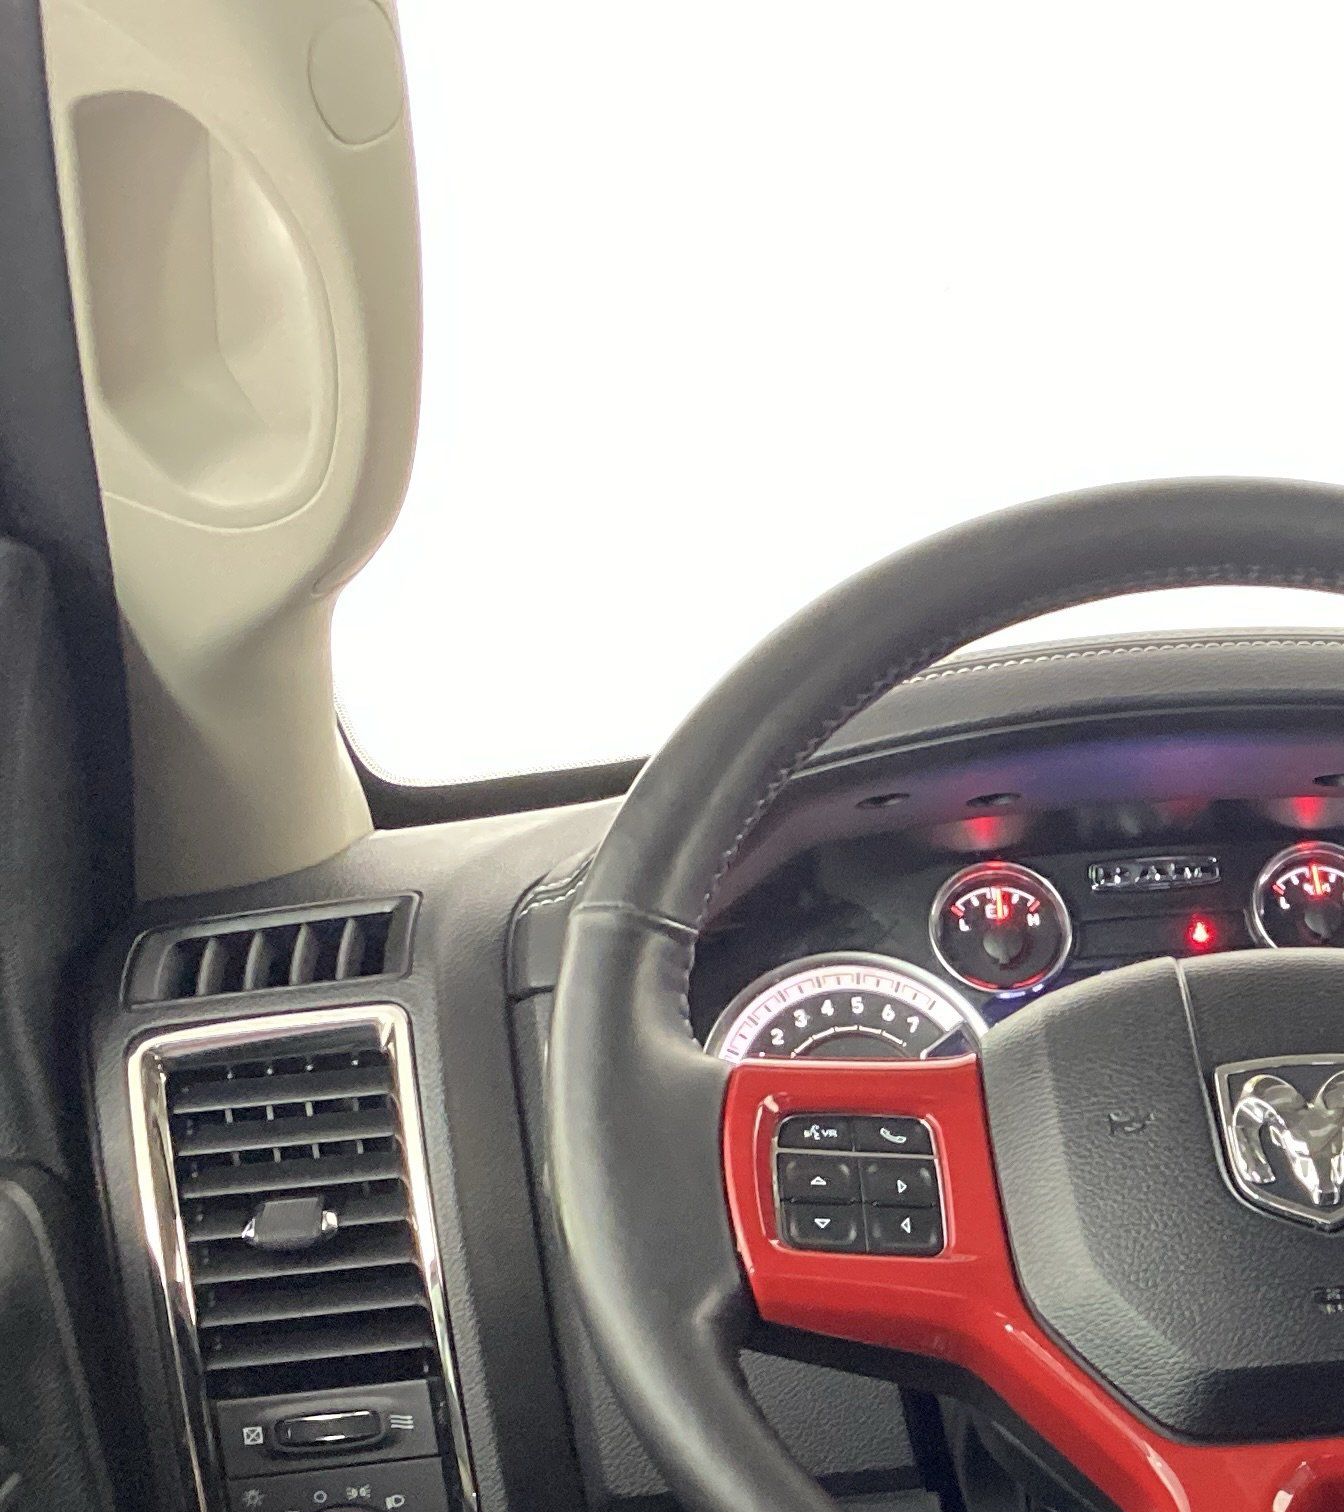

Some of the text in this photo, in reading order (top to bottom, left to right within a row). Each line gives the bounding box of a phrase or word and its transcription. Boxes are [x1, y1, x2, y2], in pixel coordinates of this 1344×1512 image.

[821, 999, 835, 1017] 4
[851, 996, 864, 1014] 5
[882, 1004, 896, 1022] 6
[794, 1009, 810, 1028] 3
[770, 1028, 785, 1046] 2
